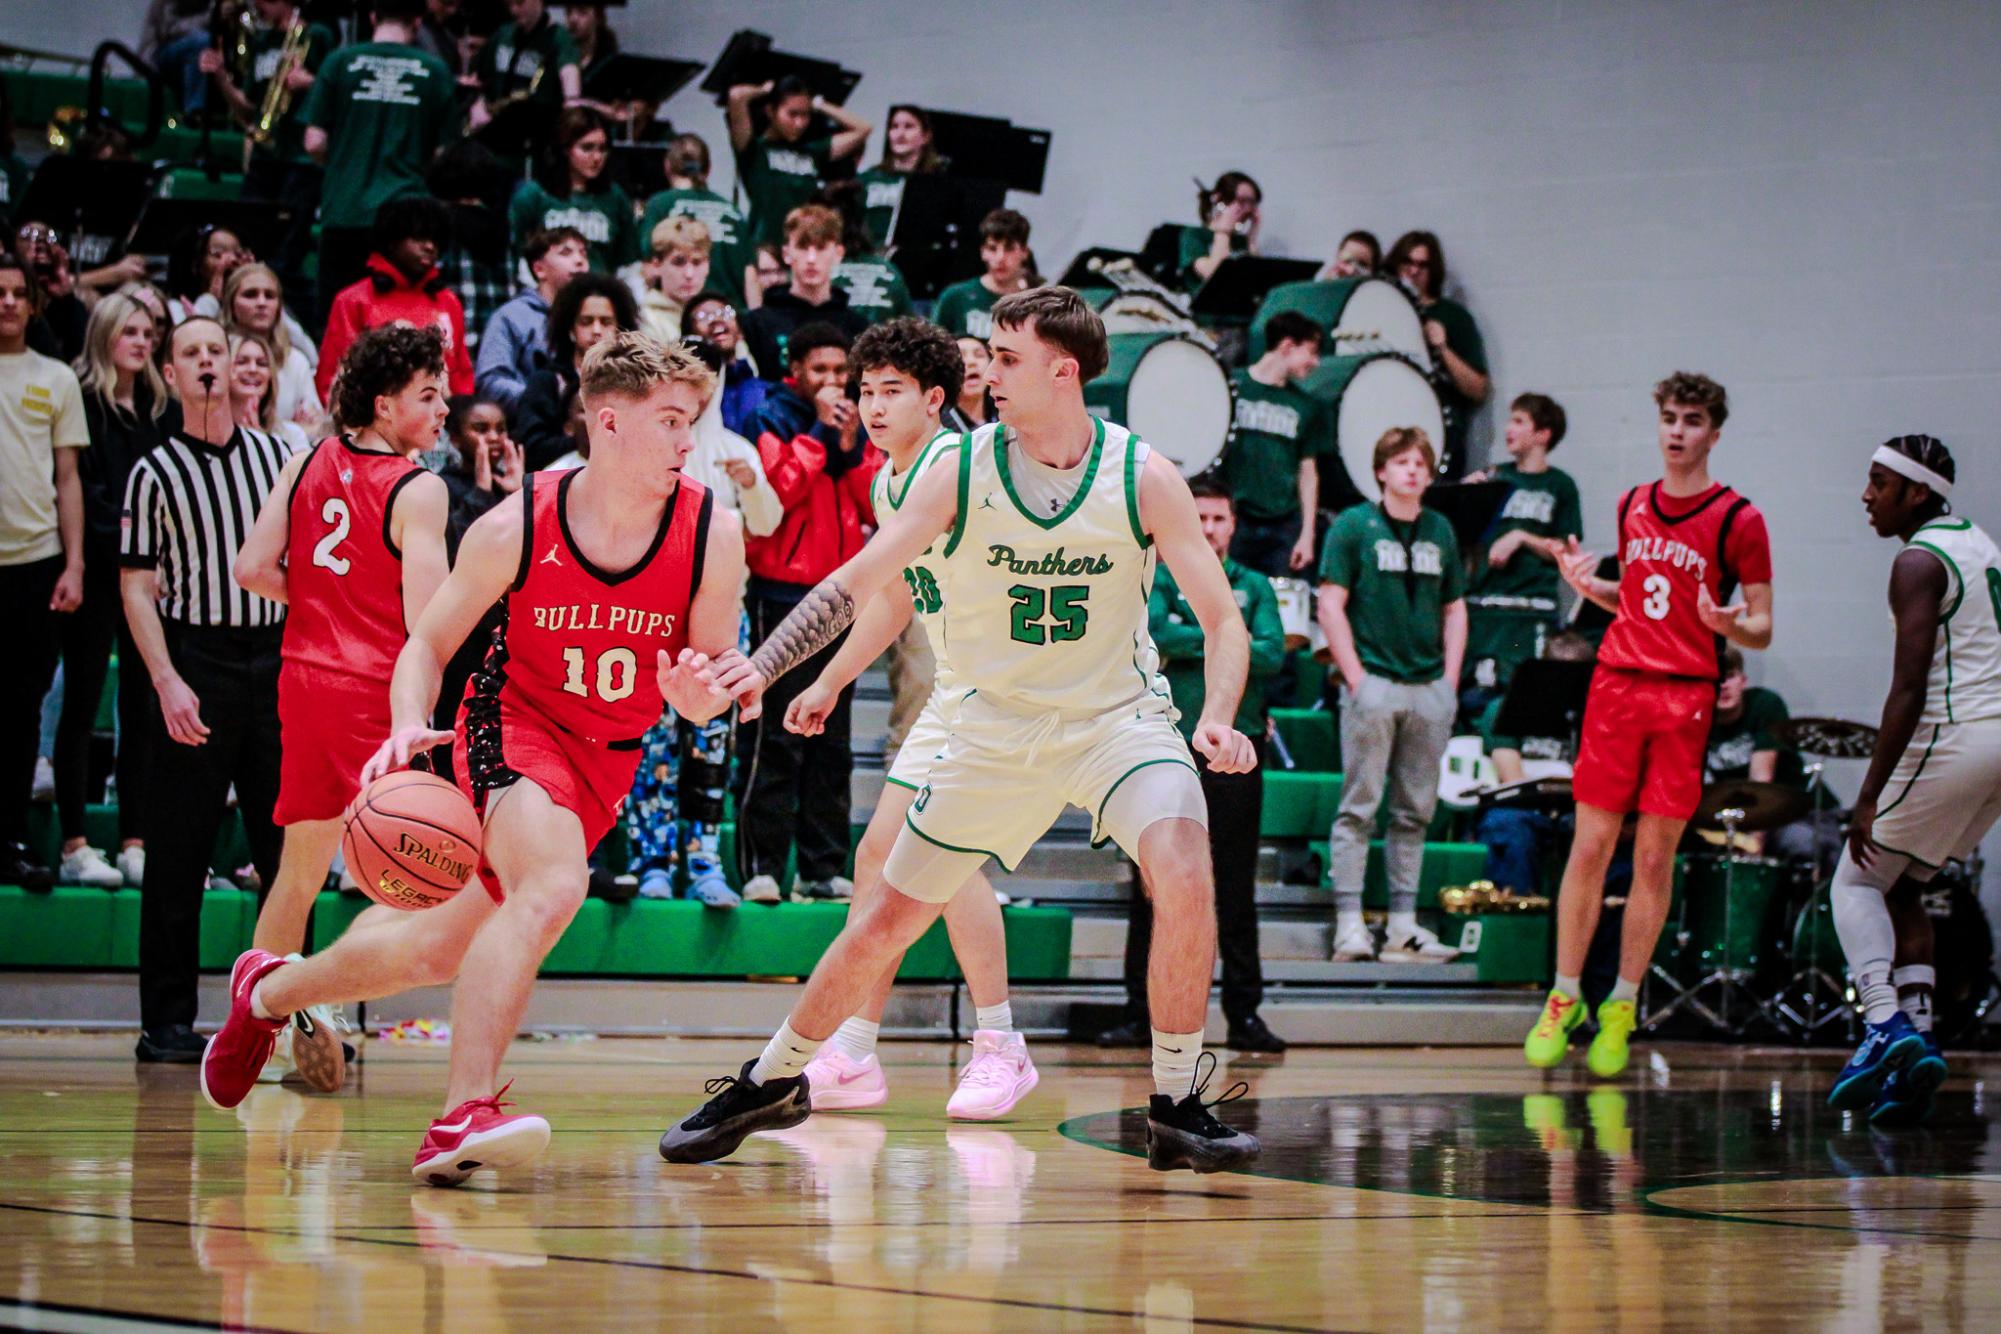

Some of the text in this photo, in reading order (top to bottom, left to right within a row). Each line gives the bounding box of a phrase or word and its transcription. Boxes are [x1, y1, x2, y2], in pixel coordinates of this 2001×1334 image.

[313, 497, 350, 575] 2
[986, 544, 1114, 576] Panthers
[1008, 584, 1090, 646] 25
[1643, 573, 1671, 620] 3
[562, 646, 637, 703] 10
[393, 833, 473, 884] SPALDING
